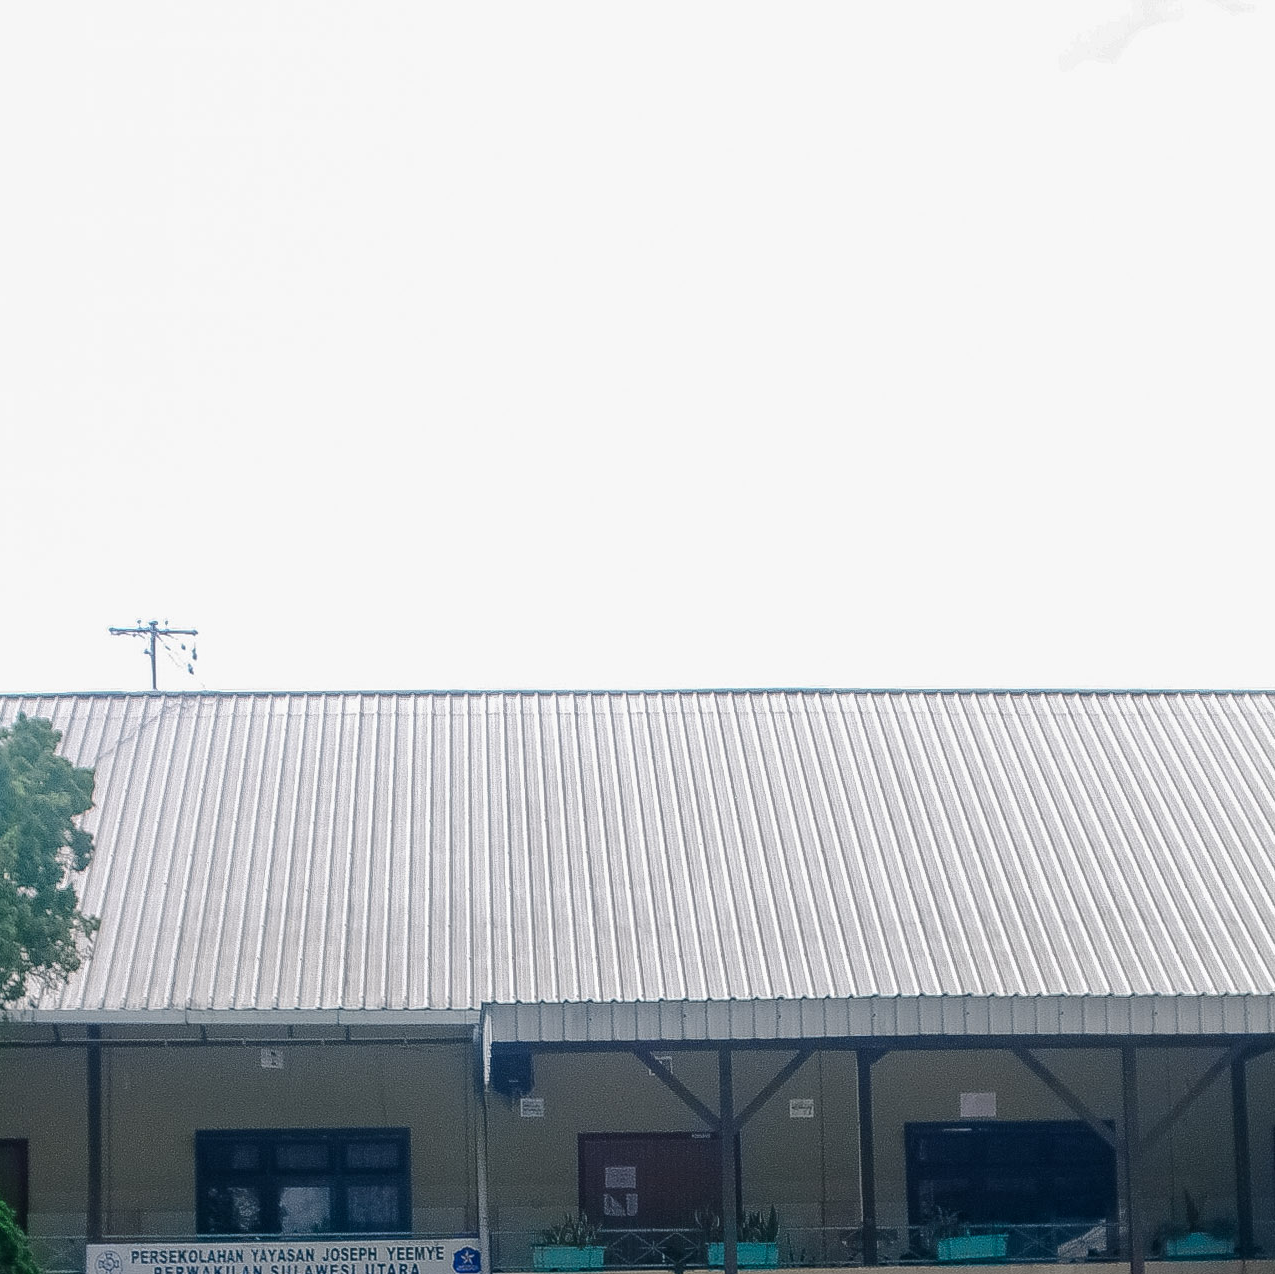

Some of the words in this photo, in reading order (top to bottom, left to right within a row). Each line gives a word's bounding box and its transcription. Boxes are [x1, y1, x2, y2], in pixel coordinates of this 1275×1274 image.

[131, 1249, 244, 1264] PERSEKOLAHAN
[251, 1248, 315, 1263] YAYASAN
[323, 1247, 378, 1262] JOSEPH
[386, 1246, 444, 1261] YEEMYE
